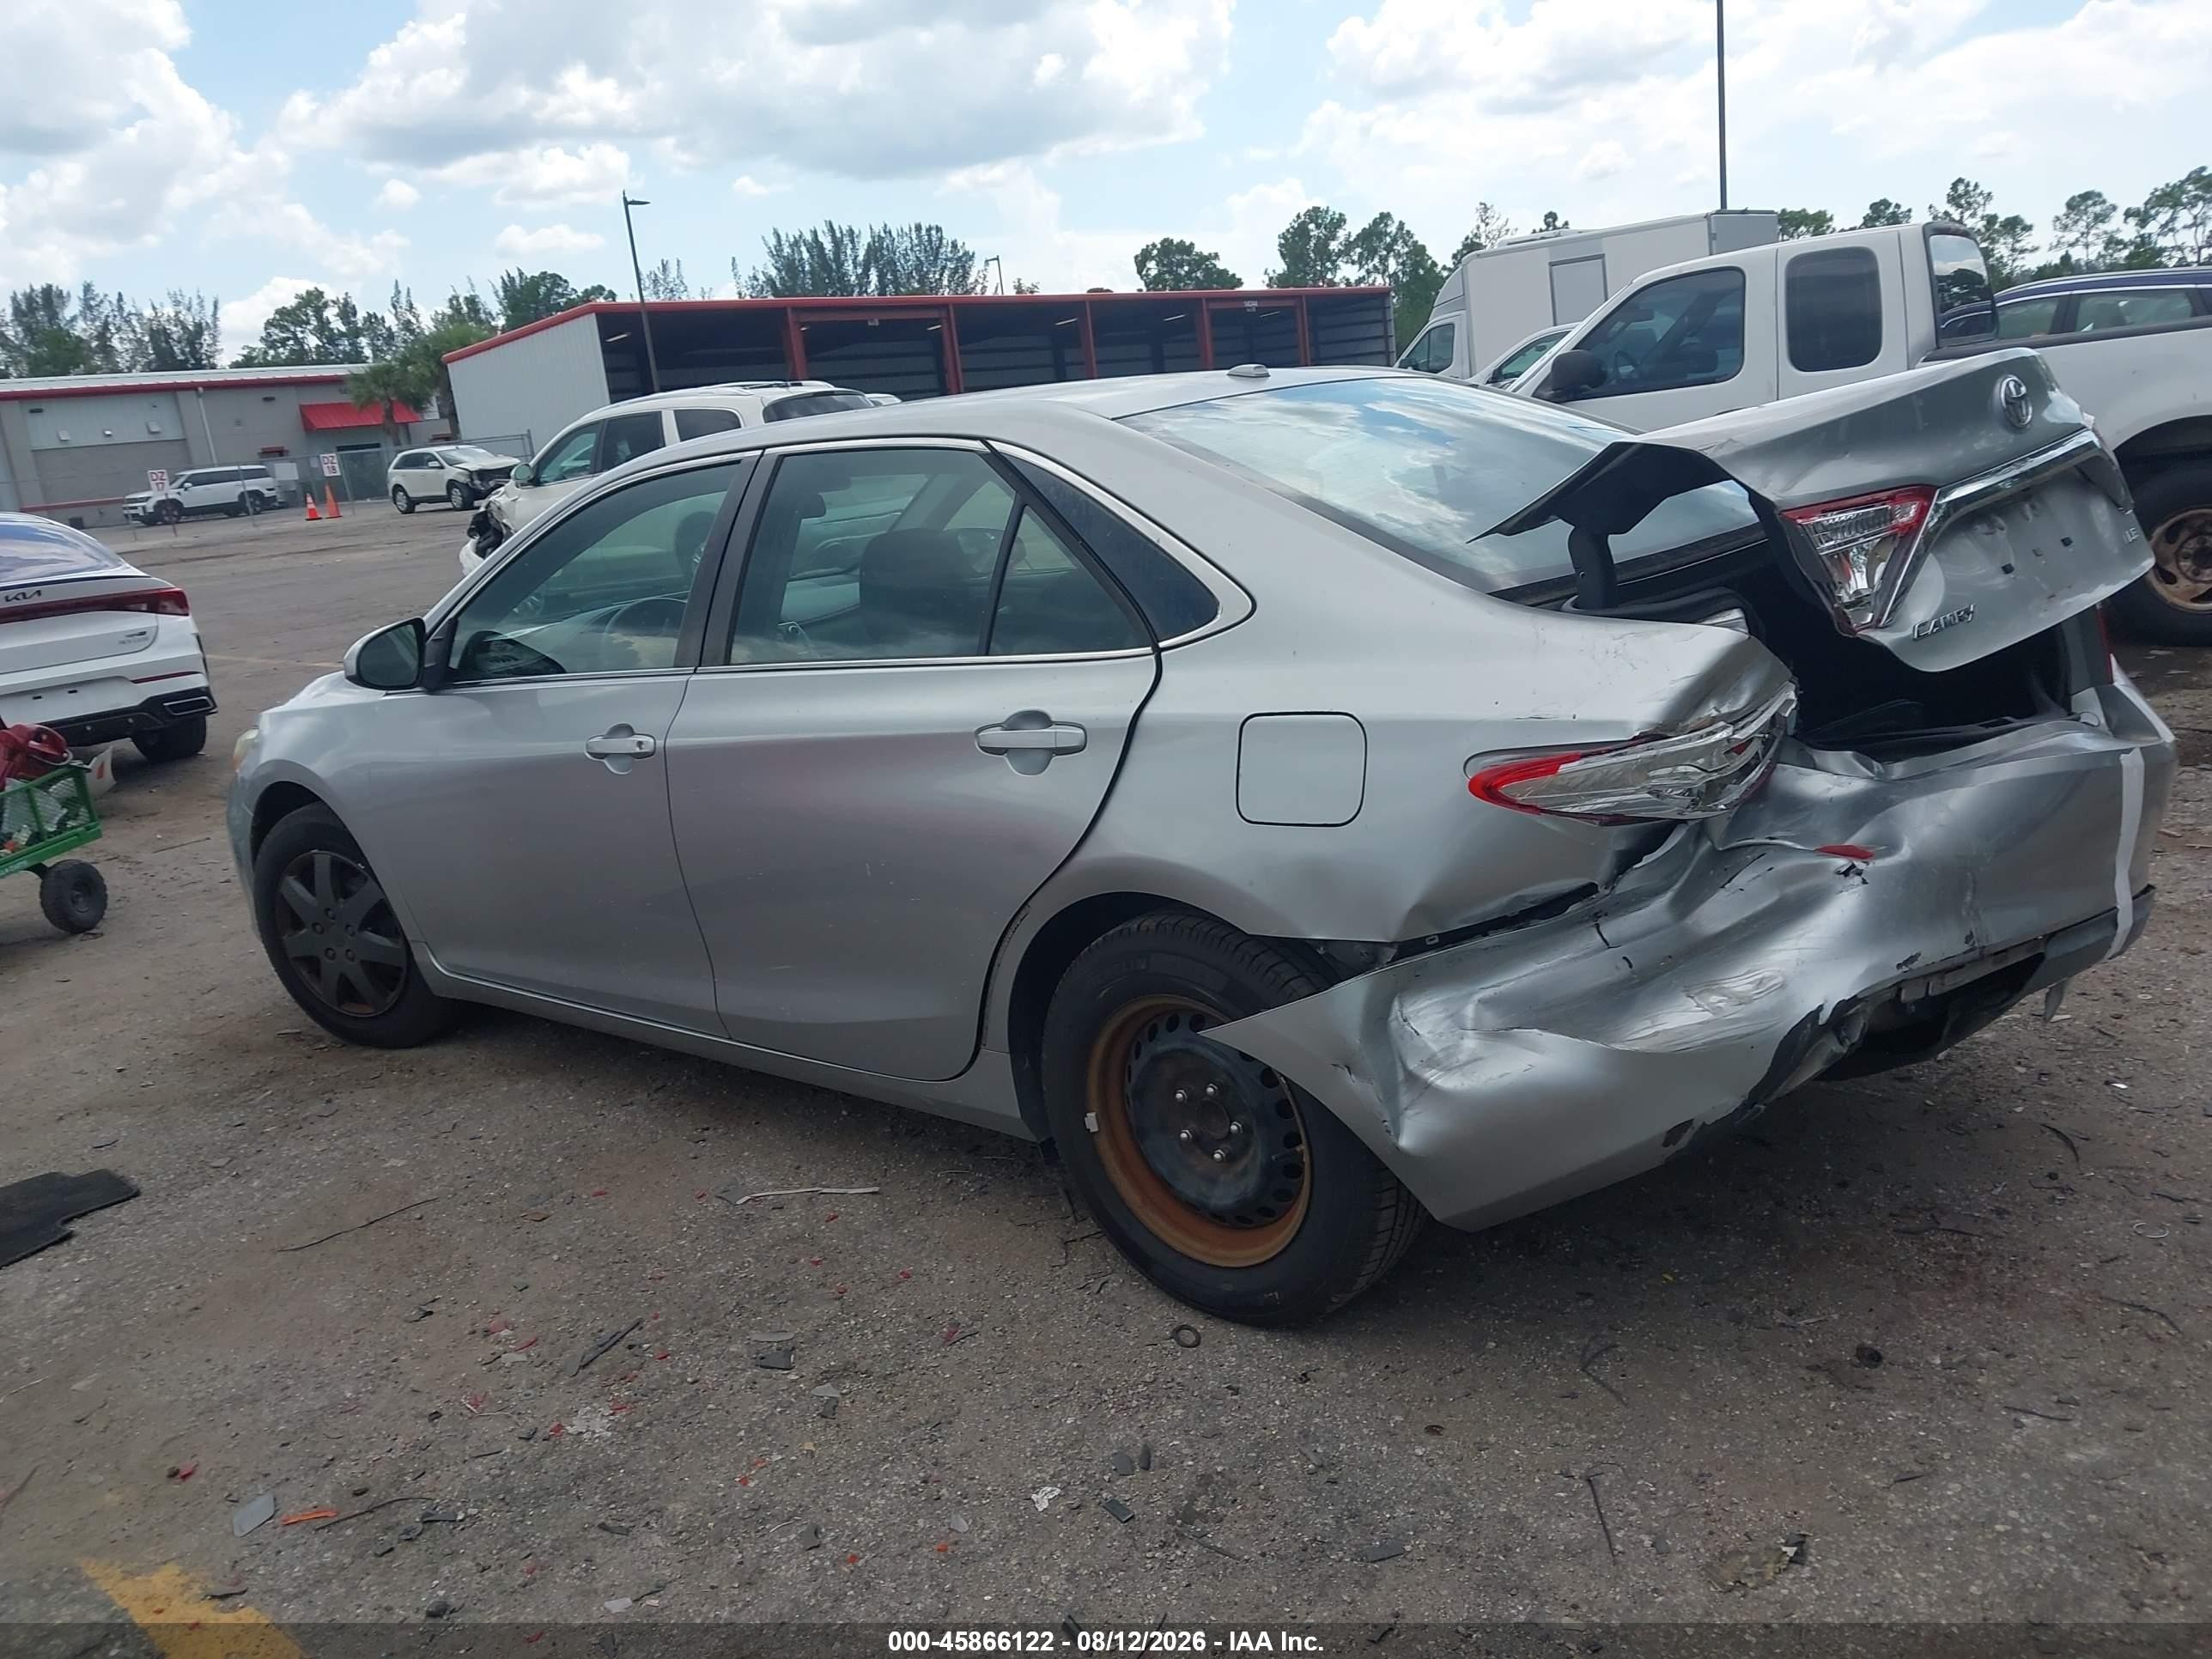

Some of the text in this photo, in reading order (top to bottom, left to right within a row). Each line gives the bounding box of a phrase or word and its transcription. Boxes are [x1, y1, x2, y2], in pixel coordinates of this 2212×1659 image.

[322, 455, 337, 465] DZ
[150, 471, 166, 481] DZ
[1913, 604, 1974, 640] CAMRY
